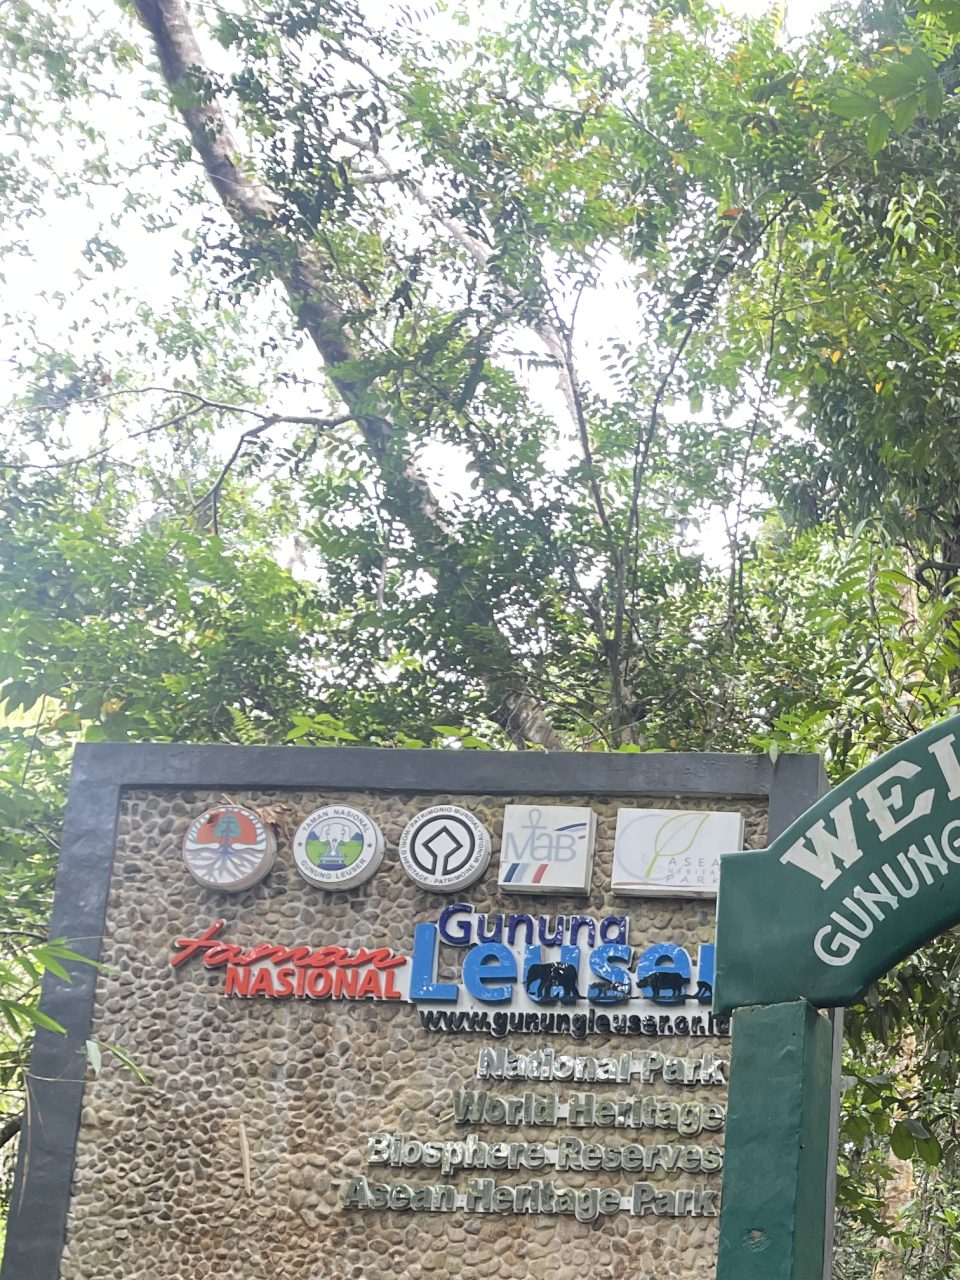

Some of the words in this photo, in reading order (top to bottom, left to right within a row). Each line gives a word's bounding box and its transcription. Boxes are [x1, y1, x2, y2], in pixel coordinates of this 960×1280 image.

[302, 810, 329, 832] TAMAN
[333, 809, 369, 833] NASIONAL
[410, 807, 453, 828] PATRIMONIO
[453, 808, 480, 831] MUNDIAL
[301, 860, 332, 880] GUNUNG
[335, 857, 367, 879] LEUSER
[401, 854, 429, 881] HERITAGE
[434, 864, 476, 884] PATRIMOINE
[667, 857, 720, 867] ASEA
[225, 967, 402, 999] NASIONAL
[477, 1047, 632, 1083] National
[641, 1051, 727, 1086] Park
[453, 1090, 558, 1126] World
[569, 1093, 725, 1136] Heritage
[368, 1132, 545, 1175] Biosphere
[556, 1136, 724, 1173] Reserves
[343, 1175, 456, 1211] Asean
[464, 1177, 622, 1221] Heritage
[631, 1182, 718, 1217] Park
